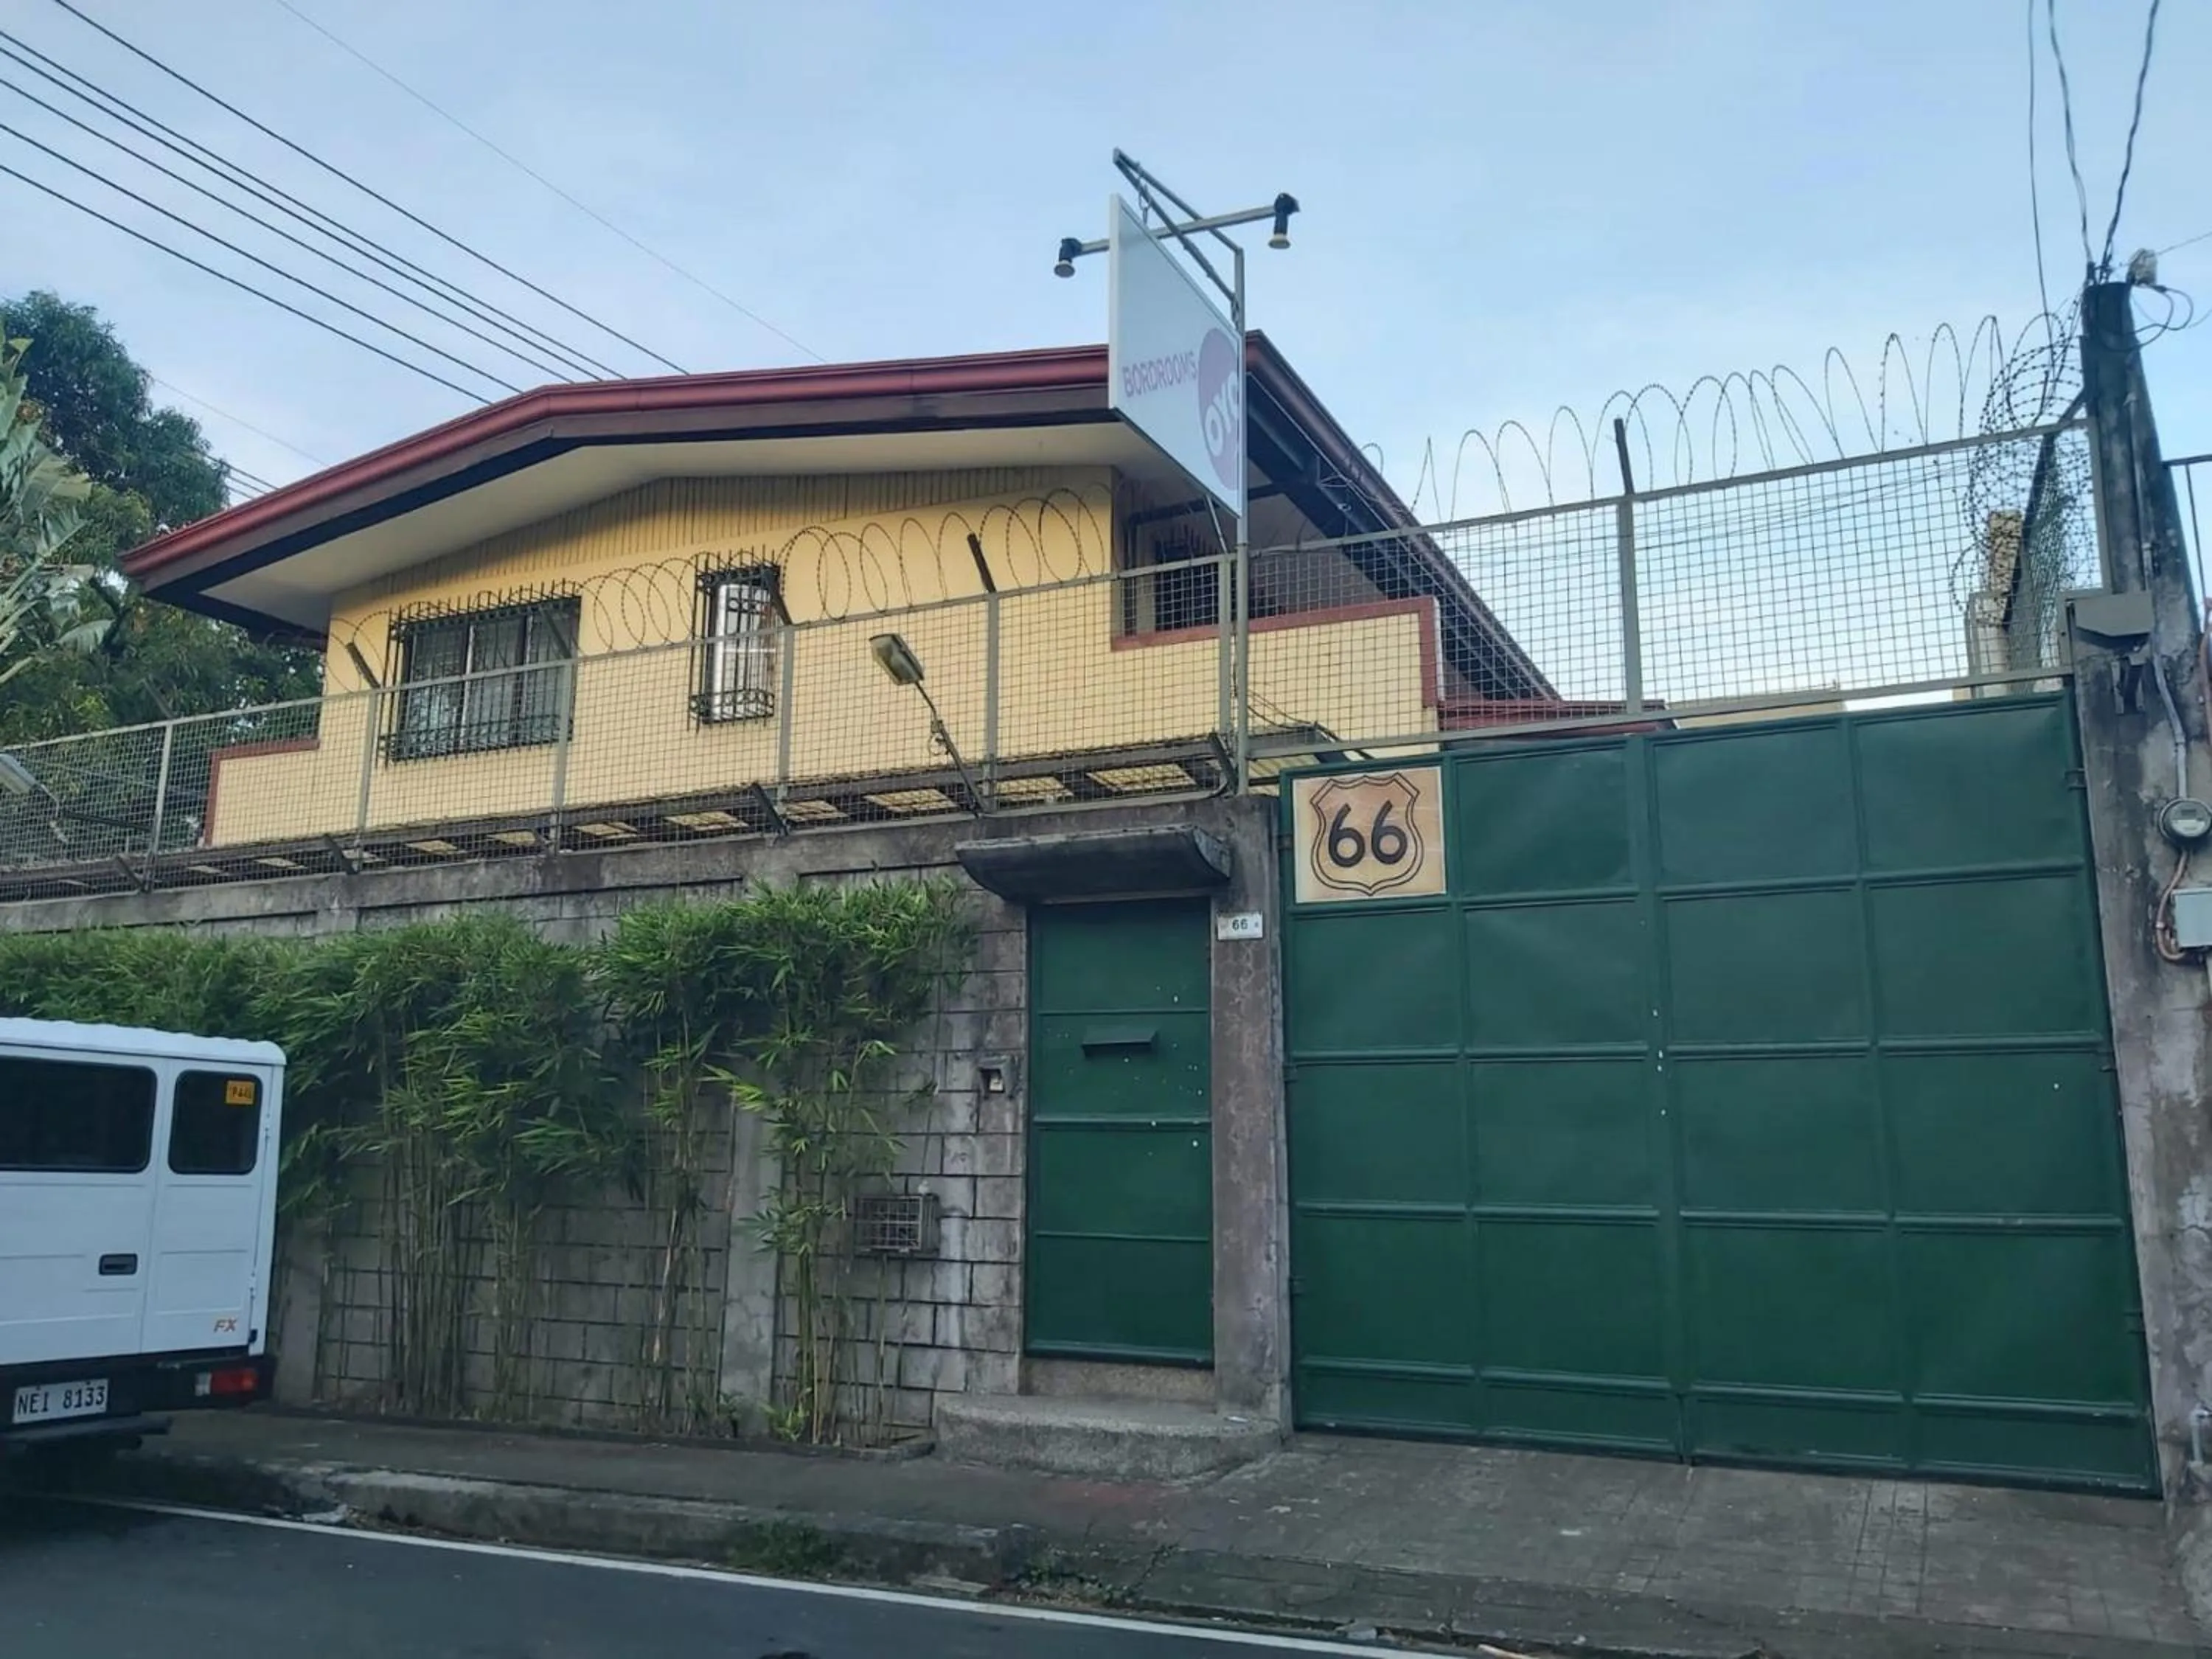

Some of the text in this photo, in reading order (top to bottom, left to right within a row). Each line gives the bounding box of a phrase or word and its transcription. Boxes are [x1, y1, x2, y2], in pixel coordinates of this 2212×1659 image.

[1329, 800, 1408, 867] 66
[1232, 918, 1248, 931] 66
[214, 1318, 237, 1332] FX
[18, 1386, 105, 1414] NEI 8133
